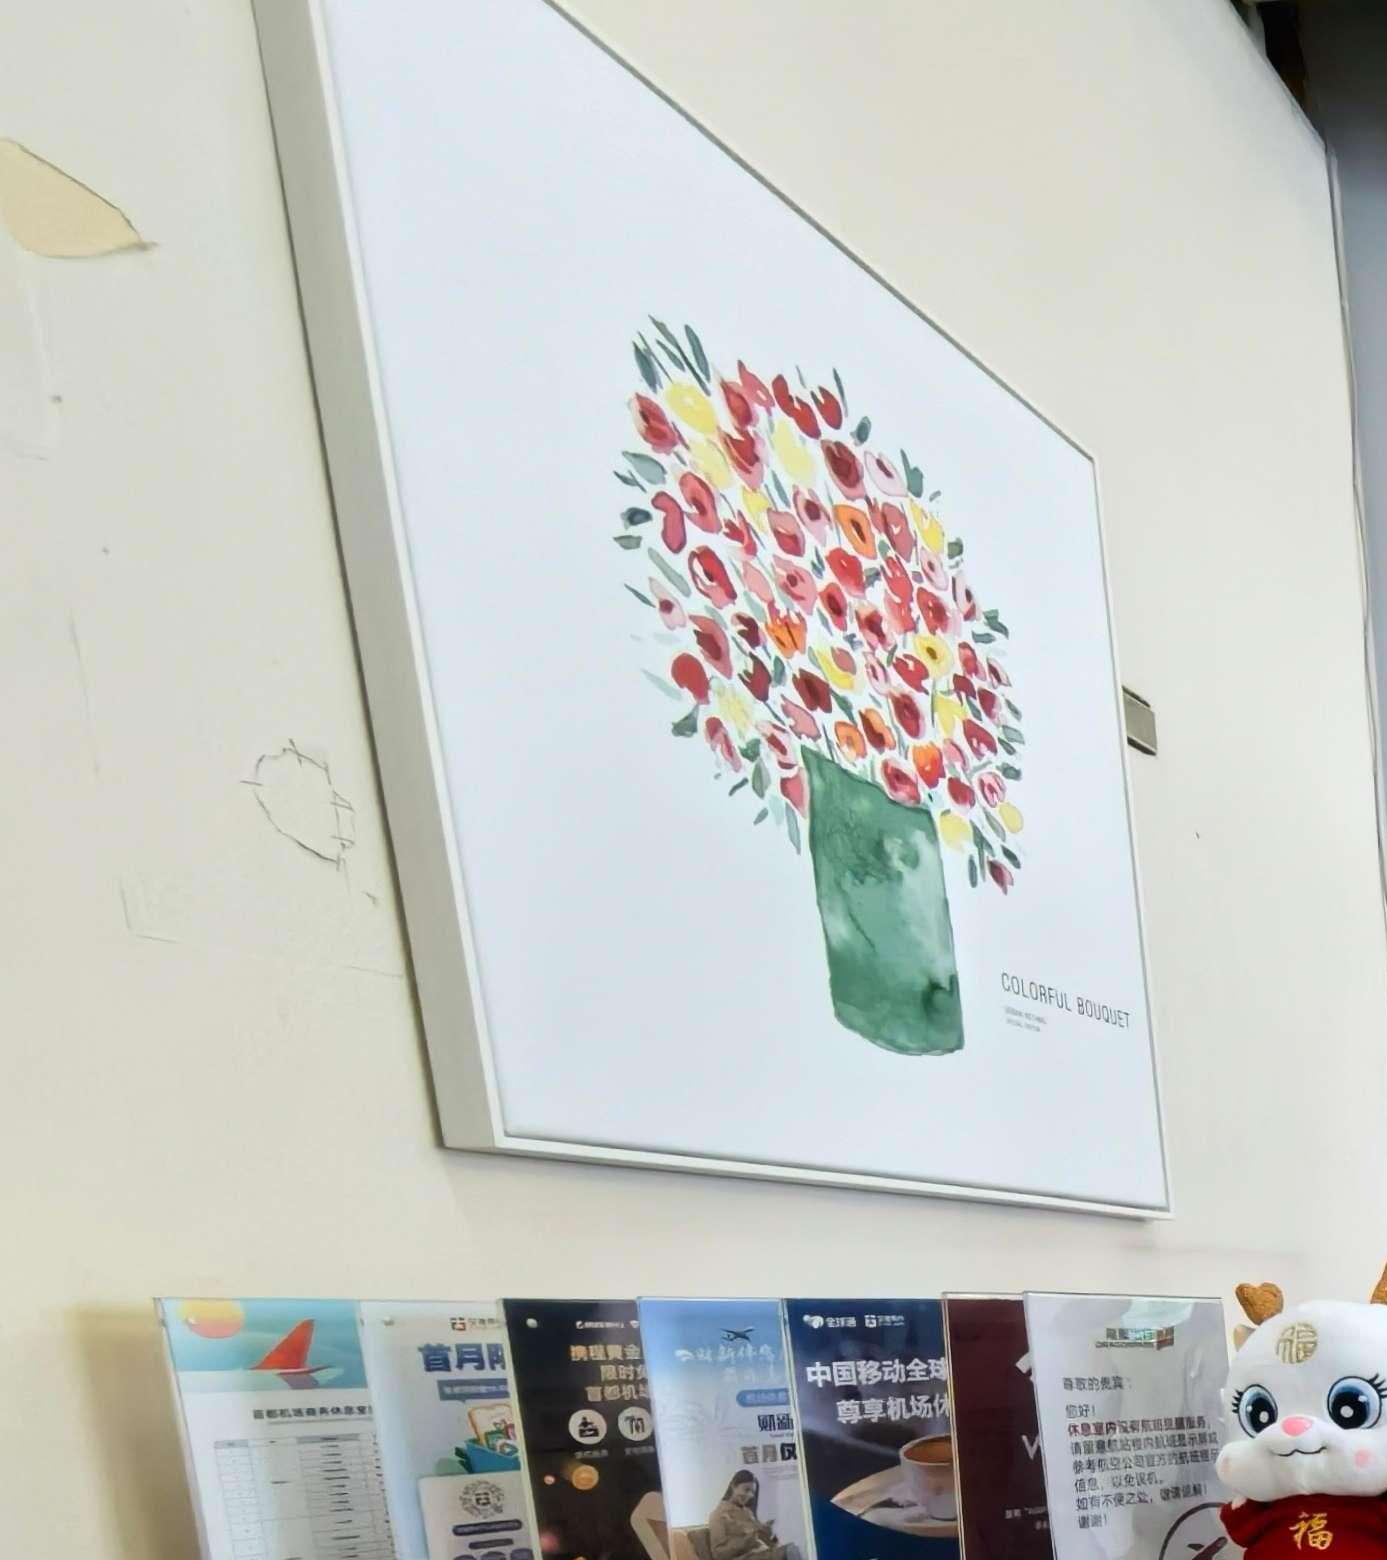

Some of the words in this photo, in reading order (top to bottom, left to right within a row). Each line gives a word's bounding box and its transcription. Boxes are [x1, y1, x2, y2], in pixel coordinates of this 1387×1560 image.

[1001, 972, 1072, 1013] COLORFUL
[1076, 996, 1130, 1029] BOUQUET
[806, 1356, 949, 1388] 中国移动全球
[1289, 1511, 1334, 1551] 福
